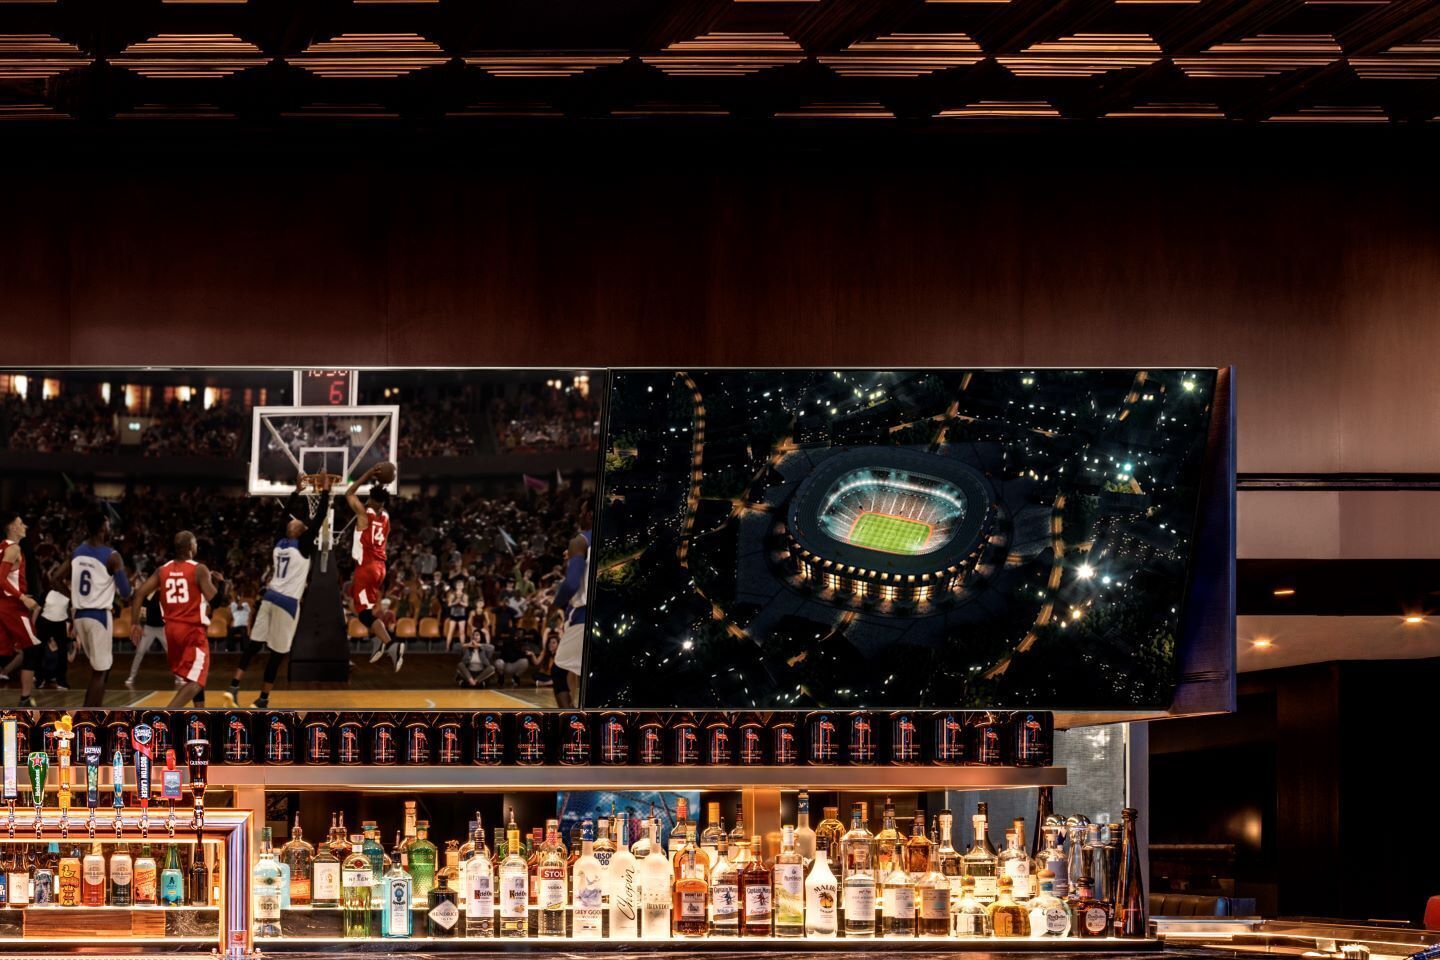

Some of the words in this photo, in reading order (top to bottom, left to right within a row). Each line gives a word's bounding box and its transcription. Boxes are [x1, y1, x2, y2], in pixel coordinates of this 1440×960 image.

[277, 556, 291, 579] 17
[79, 569, 92, 597] 6
[165, 578, 190, 604] 23
[140, 756, 148, 779] BOSTON
[140, 779, 148, 799] LAGER
[616, 864, 636, 921] Chopin
